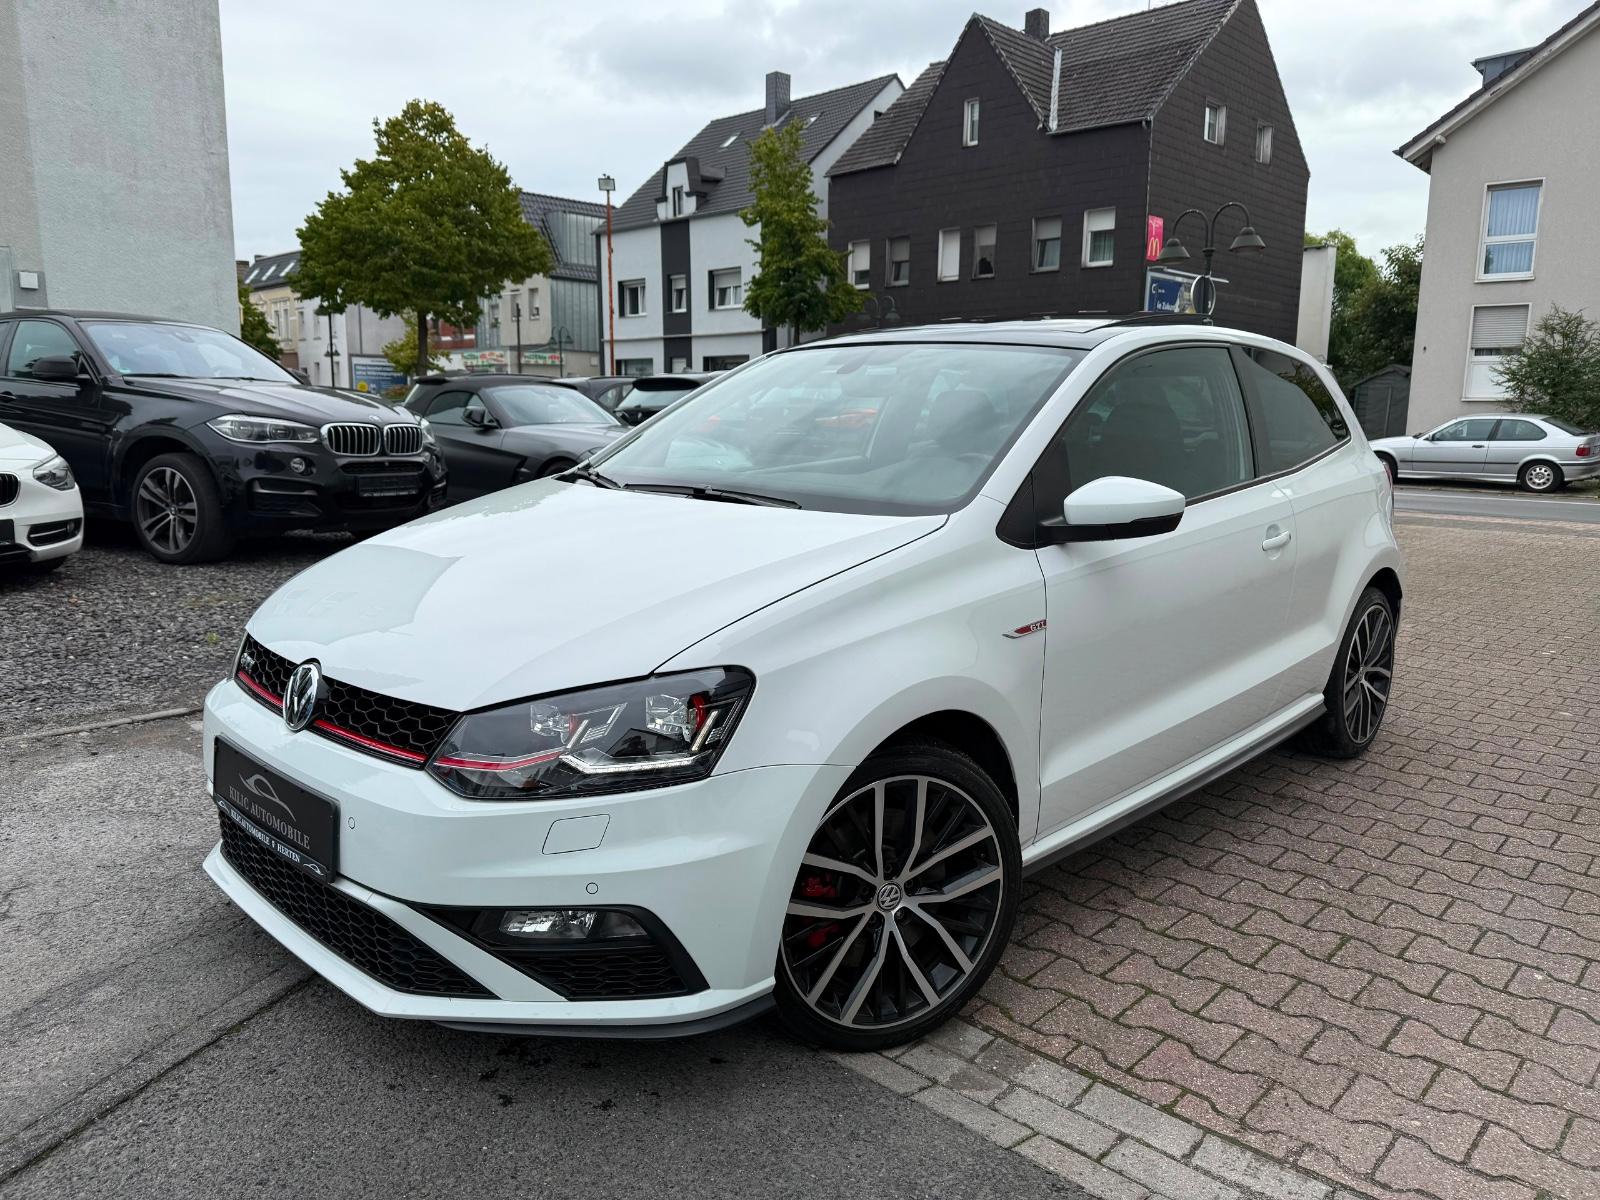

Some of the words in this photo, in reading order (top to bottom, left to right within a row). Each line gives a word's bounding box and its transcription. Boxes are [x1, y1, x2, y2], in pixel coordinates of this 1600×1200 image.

[1030, 622, 1046, 632] GTI
[229, 786, 249, 810] KILIC
[251, 801, 310, 850] AUTOMOBILE
[277, 844, 300, 862] HERTEN
